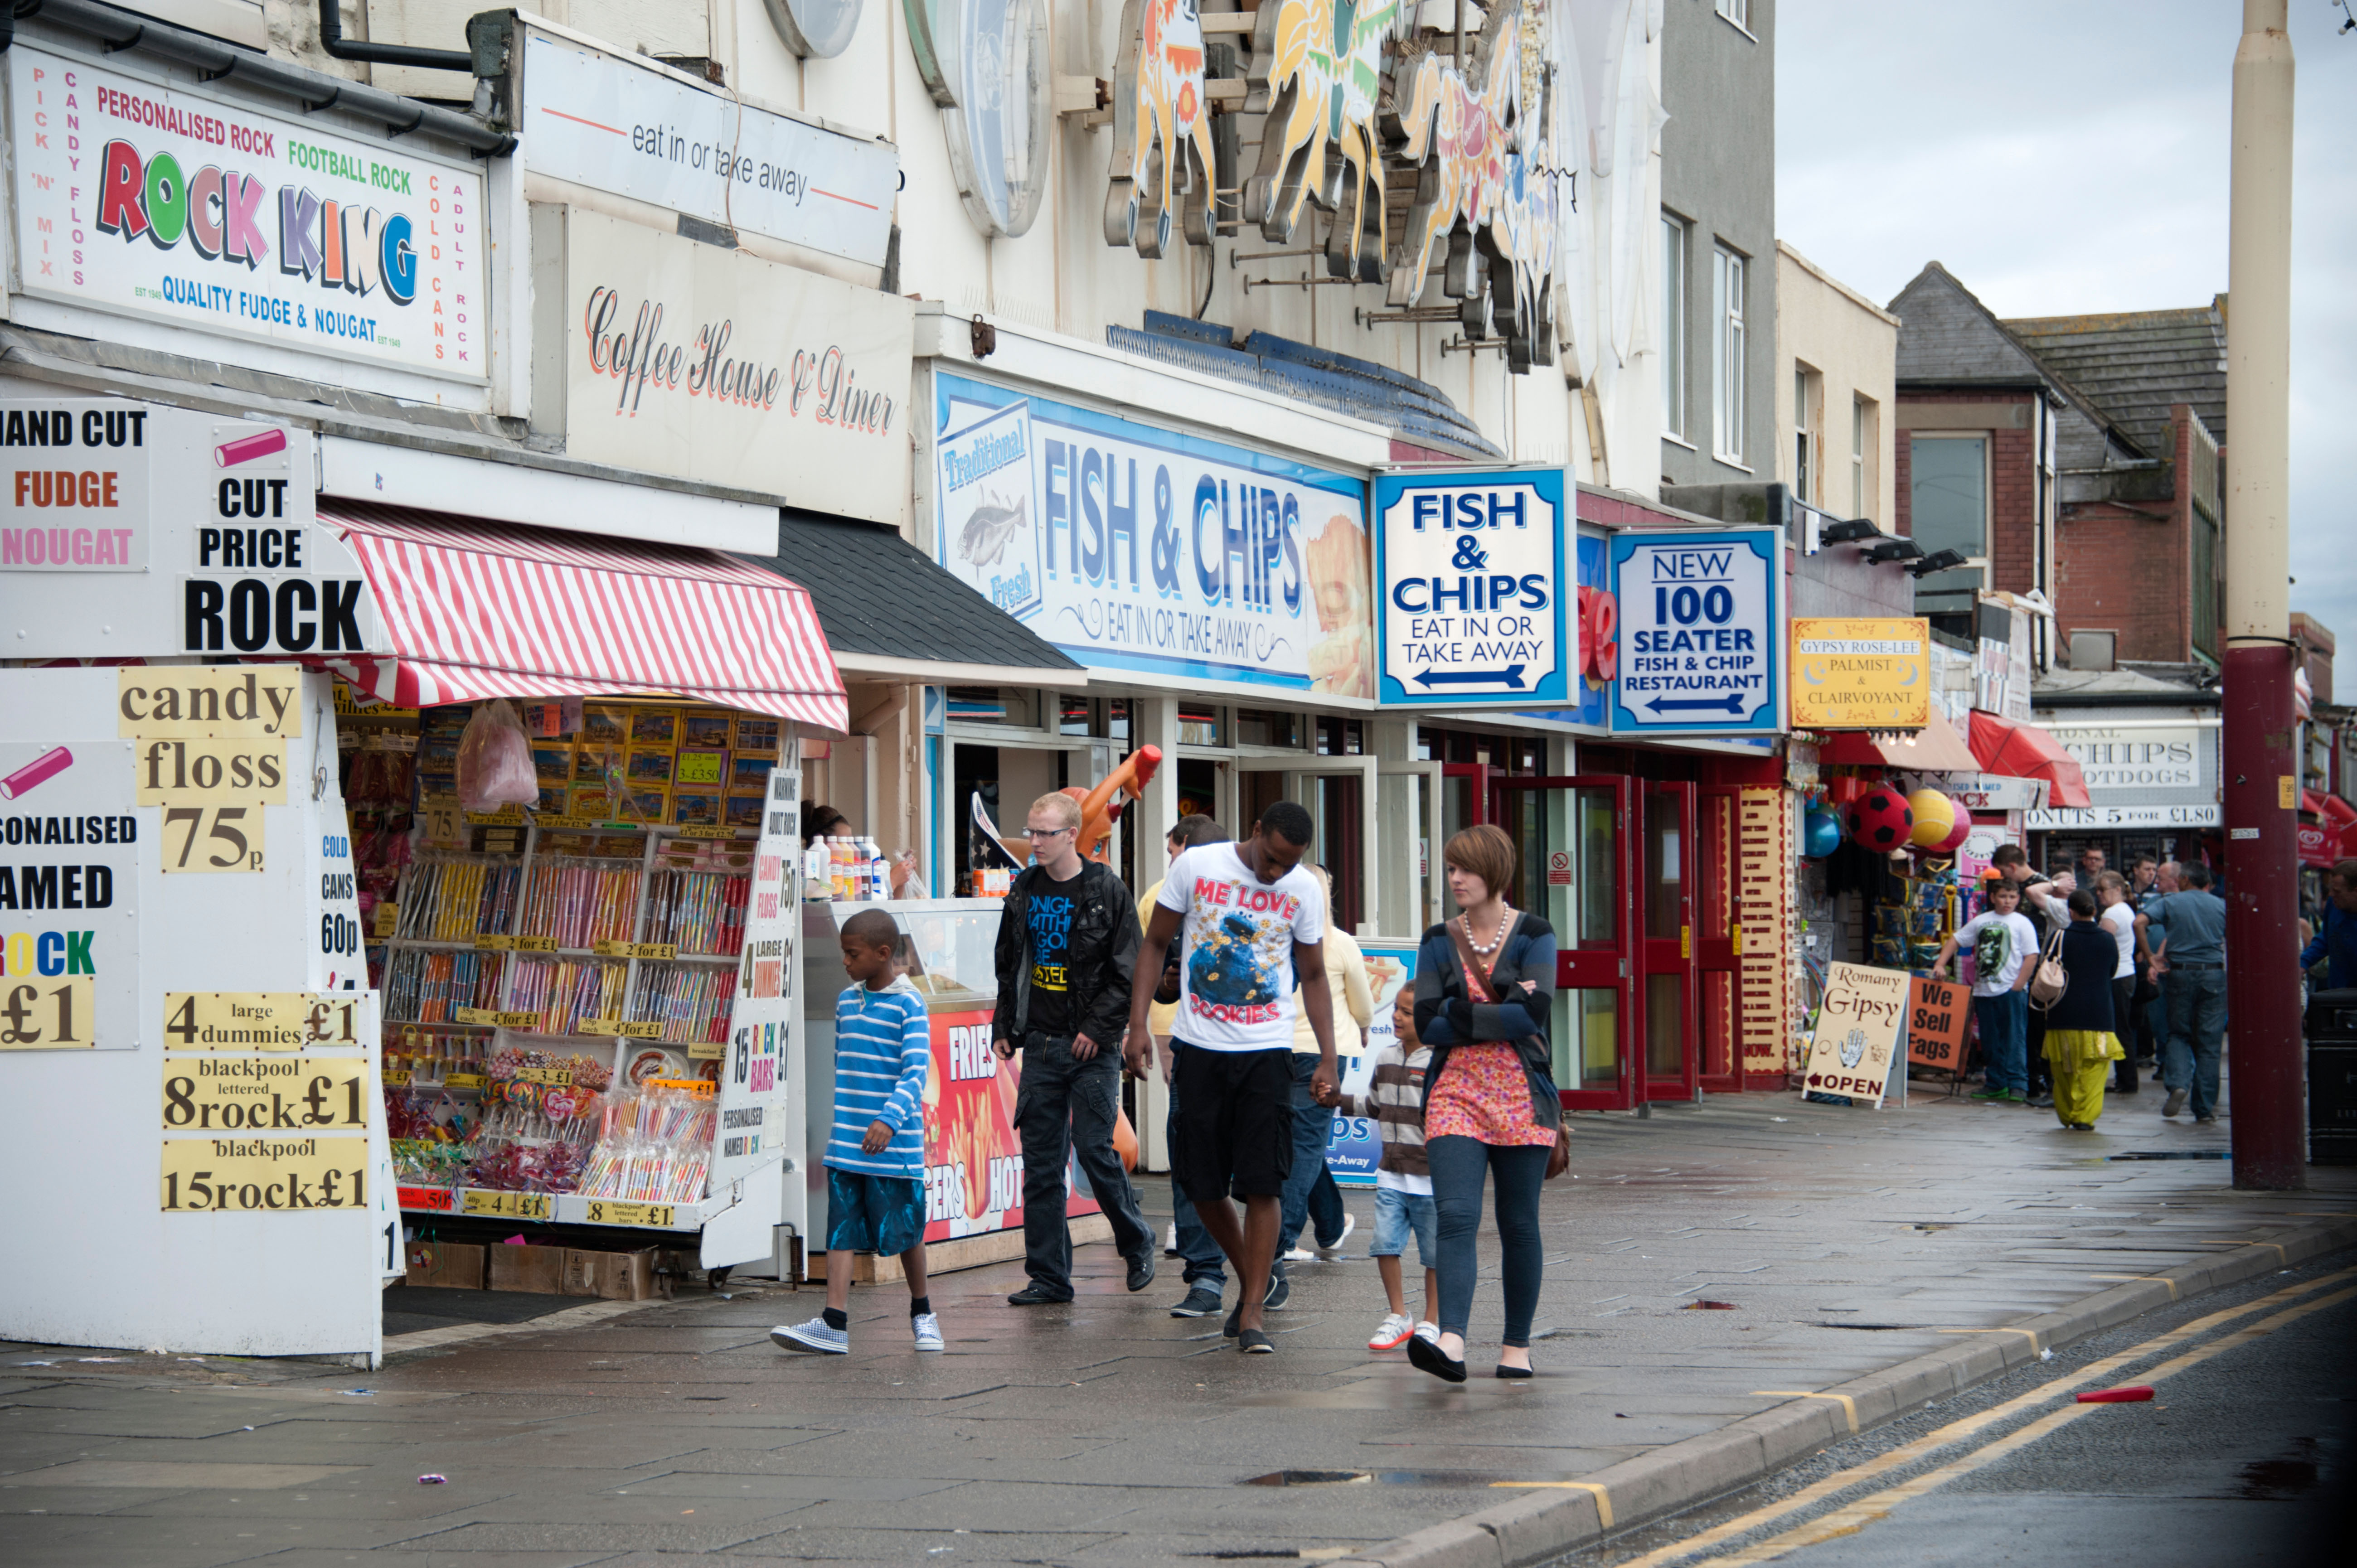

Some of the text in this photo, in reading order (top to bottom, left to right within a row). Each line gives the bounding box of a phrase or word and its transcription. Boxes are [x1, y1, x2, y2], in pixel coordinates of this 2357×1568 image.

[33, 67, 49, 150] PICK
[98, 86, 276, 158] PERSONALISED ROCK
[65, 72, 84, 286] CANDY FLOSS
[288, 140, 412, 195] FOOTBALL ROCK
[633, 123, 807, 207] eat in or take away
[97, 138, 418, 306] ROCK KING
[38, 217, 53, 276] MIX
[430, 176, 444, 360] COLD CANS
[453, 185, 469, 362] ADULT ROCK
[135, 287, 162, 300] EST 1949
[162, 275, 376, 343] QUALITY FUDGE & NOUGAT
[378, 335, 401, 348] EST 1949
[585, 286, 898, 436] Coffee House Diner
[82, 411, 147, 447] CUT
[944, 418, 1026, 493] Traditional
[15, 470, 118, 508] FUDGE
[218, 479, 288, 518] CUT
[1045, 438, 1301, 618] FISH & CHIPS
[1413, 492, 1526, 532] FISH
[2, 528, 133, 565] NOUGAT
[200, 528, 301, 568] PRICE
[1452, 535, 1489, 571] &
[1654, 552, 1732, 579] NEW
[990, 562, 1033, 613] Fresh
[1393, 574, 1550, 614] CHIPS
[185, 579, 364, 652] ROCK
[1655, 586, 1734, 627] 100
[1109, 602, 1251, 659] EAT IN OR TAKE AWAY
[1412, 616, 1534, 638] EAT IN OR
[1634, 629, 1755, 653] SEATER
[1403, 641, 1543, 663] TAKE AWAY
[1634, 656, 1754, 672] FISH & CHIP
[1801, 642, 1919, 653] GYPSY ROSE-LEE
[1830, 660, 1891, 671] PALMIST
[1626, 675, 1763, 691] RESTAURANT
[1808, 692, 1913, 704] CLAIRVOYANT
[121, 674, 295, 733] candy
[144, 742, 281, 789] floss
[774, 776, 796, 801] WARNING
[0, 816, 136, 845] ONALISED
[769, 811, 796, 836] ADULT ROCK
[2107, 809, 2122, 823] 5
[2129, 811, 2158, 821] FOR
[2170, 808, 2214, 823] £1.80
[164, 808, 263, 870] 75p
[323, 836, 347, 858] COLD
[322, 873, 353, 900] CANS
[758, 855, 796, 913] CANDY 75p
[1194, 876, 1301, 921] ME LOVE
[757, 892, 778, 919] FLOSS
[321, 913, 357, 957] 60p
[519, 939, 538, 949] for
[541, 939, 556, 950] £1
[626, 945, 633, 955] 2
[638, 945, 656, 956] for
[660, 946, 674, 957] £1
[0, 930, 96, 977] OCK
[742, 943, 754, 998] 4
[756, 939, 782, 957] LARGE
[754, 960, 781, 998] DUMMIES
[1834, 966, 1901, 993] Romany
[1922, 983, 1952, 1007] We
[0, 984, 81, 1044] £1
[166, 995, 358, 1043] 4 large £1
[491, 1013, 498, 1024] 4
[503, 1014, 522, 1024] for
[524, 1014, 538, 1024] £1
[1190, 993, 1281, 1026] COOKIES
[1824, 987, 1898, 1027] Gipsy
[1914, 1009, 1951, 1033] Sell
[201, 1025, 301, 1045] dummies
[613, 1024, 621, 1034] 4
[624, 1023, 643, 1035] for
[646, 1024, 660, 1035] £1
[1908, 1033, 1950, 1061] Fags
[199, 1059, 300, 1081] blackpool
[734, 1020, 789, 1084] 15 ROCK £1
[949, 1023, 996, 1081] FRIES
[218, 1083, 270, 1095] lettered
[539, 1070, 570, 1083] 3 £1
[751, 1058, 774, 1093] BARS
[1824, 1074, 1882, 1095] OPEN
[723, 1107, 762, 1129] PERSONALISED
[216, 1139, 316, 1161] blackpool
[724, 1135, 760, 1158] NAMED ROCK
[990, 1155, 1025, 1213] HOT
[466, 1196, 540, 1215] 40p 4 £1
[591, 1202, 670, 1225] 8 blackpool £1
